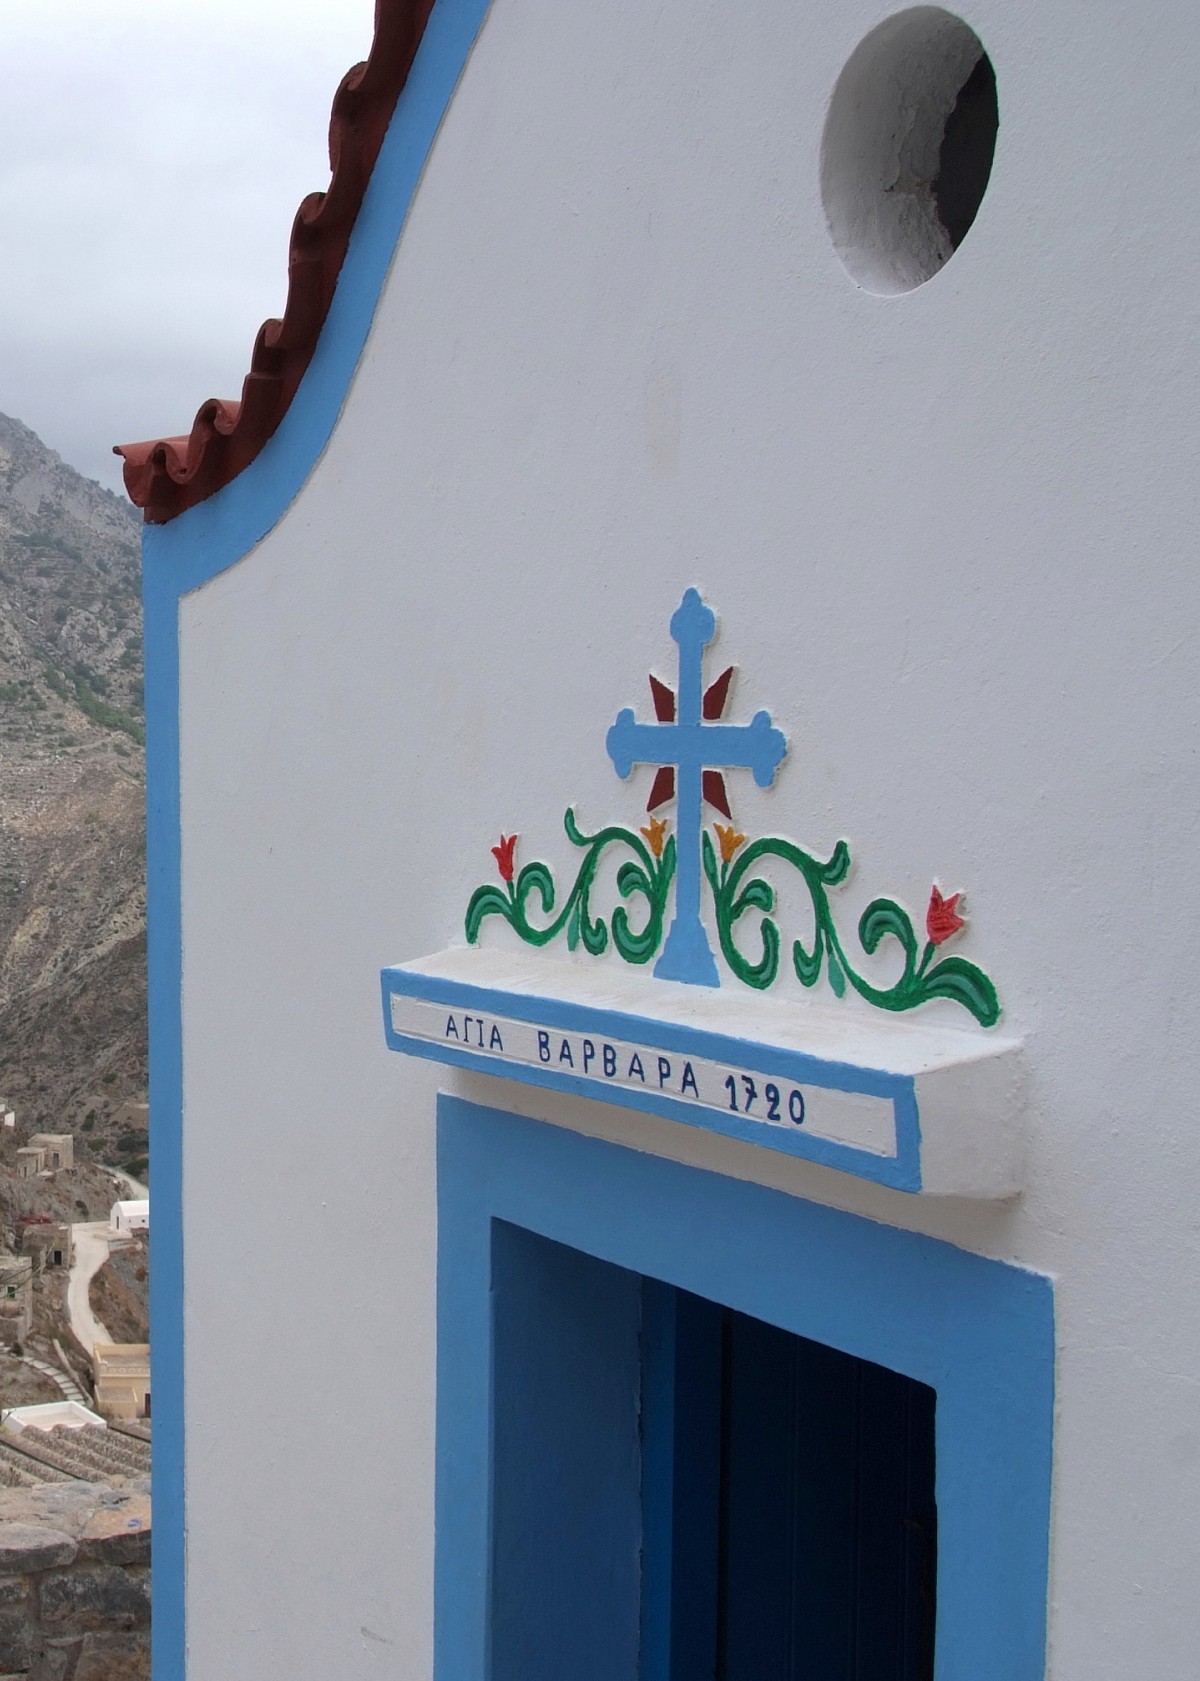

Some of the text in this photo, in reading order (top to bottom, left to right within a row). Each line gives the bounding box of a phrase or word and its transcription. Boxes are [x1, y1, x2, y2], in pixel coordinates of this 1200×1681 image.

[445, 1014, 805, 1125] ΑΓΙΑ ΒΑΡΒΑΡΑ 1720
